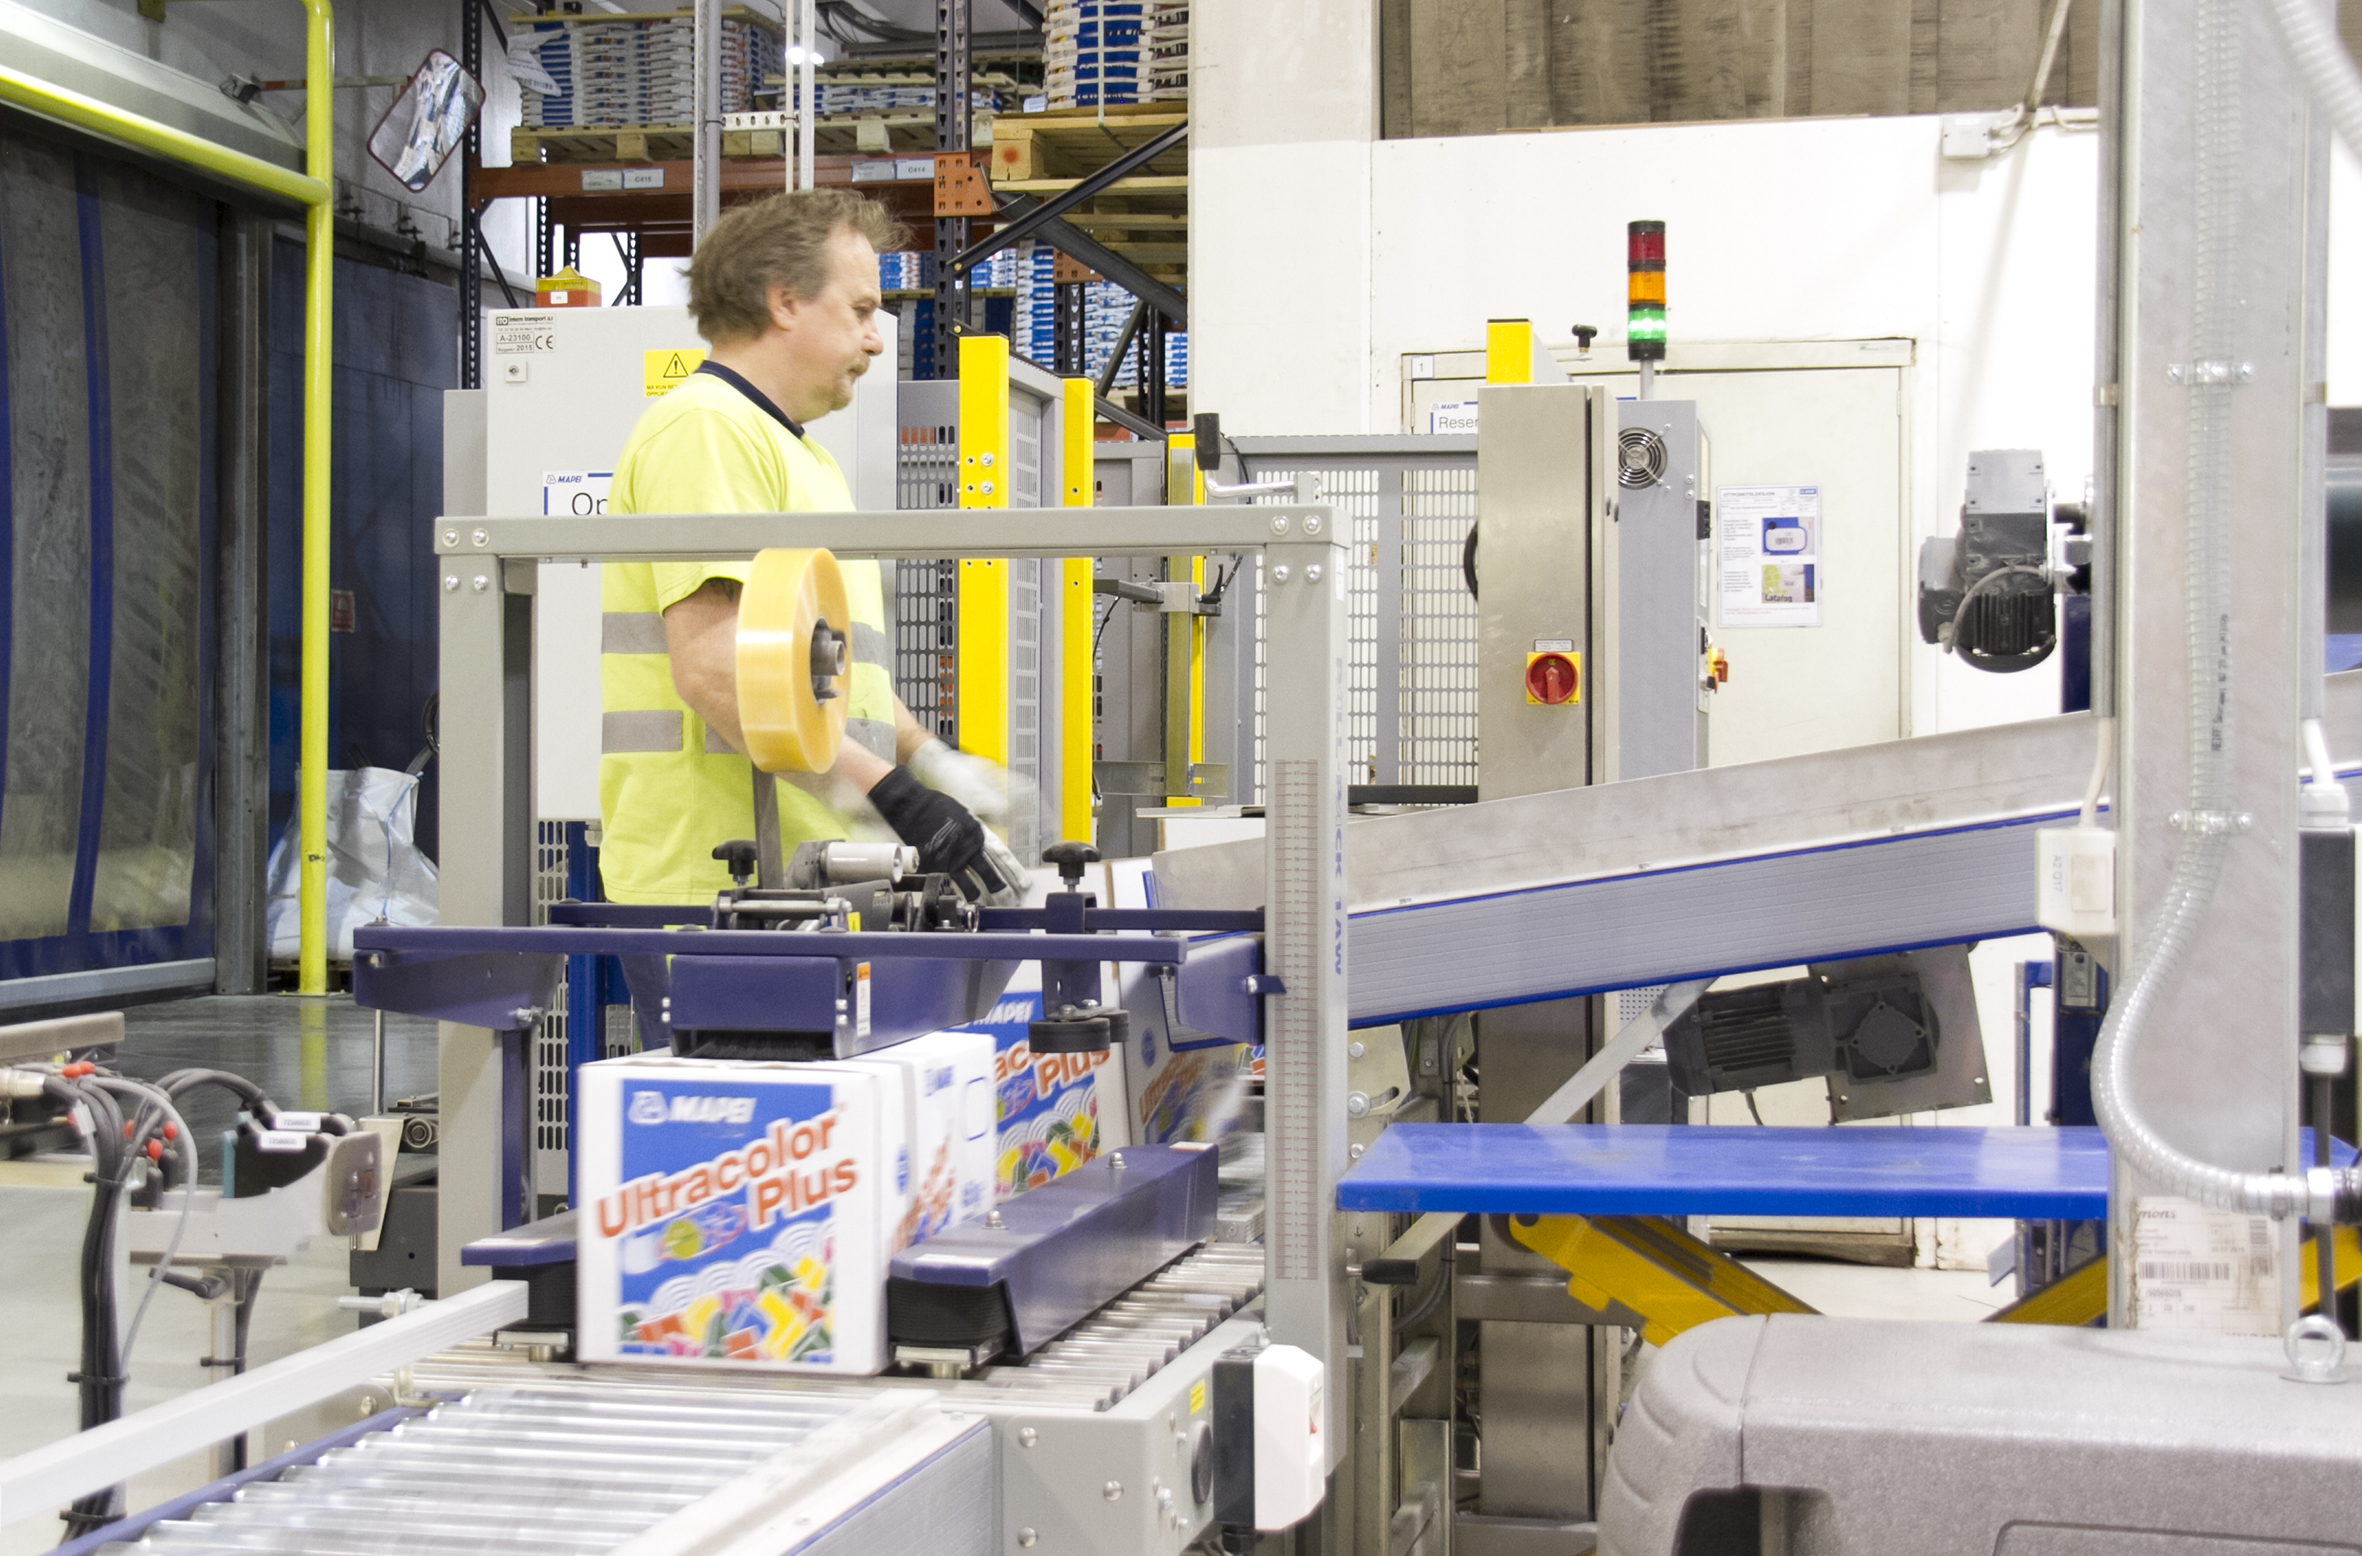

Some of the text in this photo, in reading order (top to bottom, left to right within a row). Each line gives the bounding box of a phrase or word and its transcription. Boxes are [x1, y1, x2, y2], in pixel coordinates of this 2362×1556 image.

[558, 475, 582, 484] MAPEI
[669, 1096, 757, 1124] MAPEI
[597, 1117, 838, 1238] Ultracolor
[756, 1158, 858, 1227] Plus
